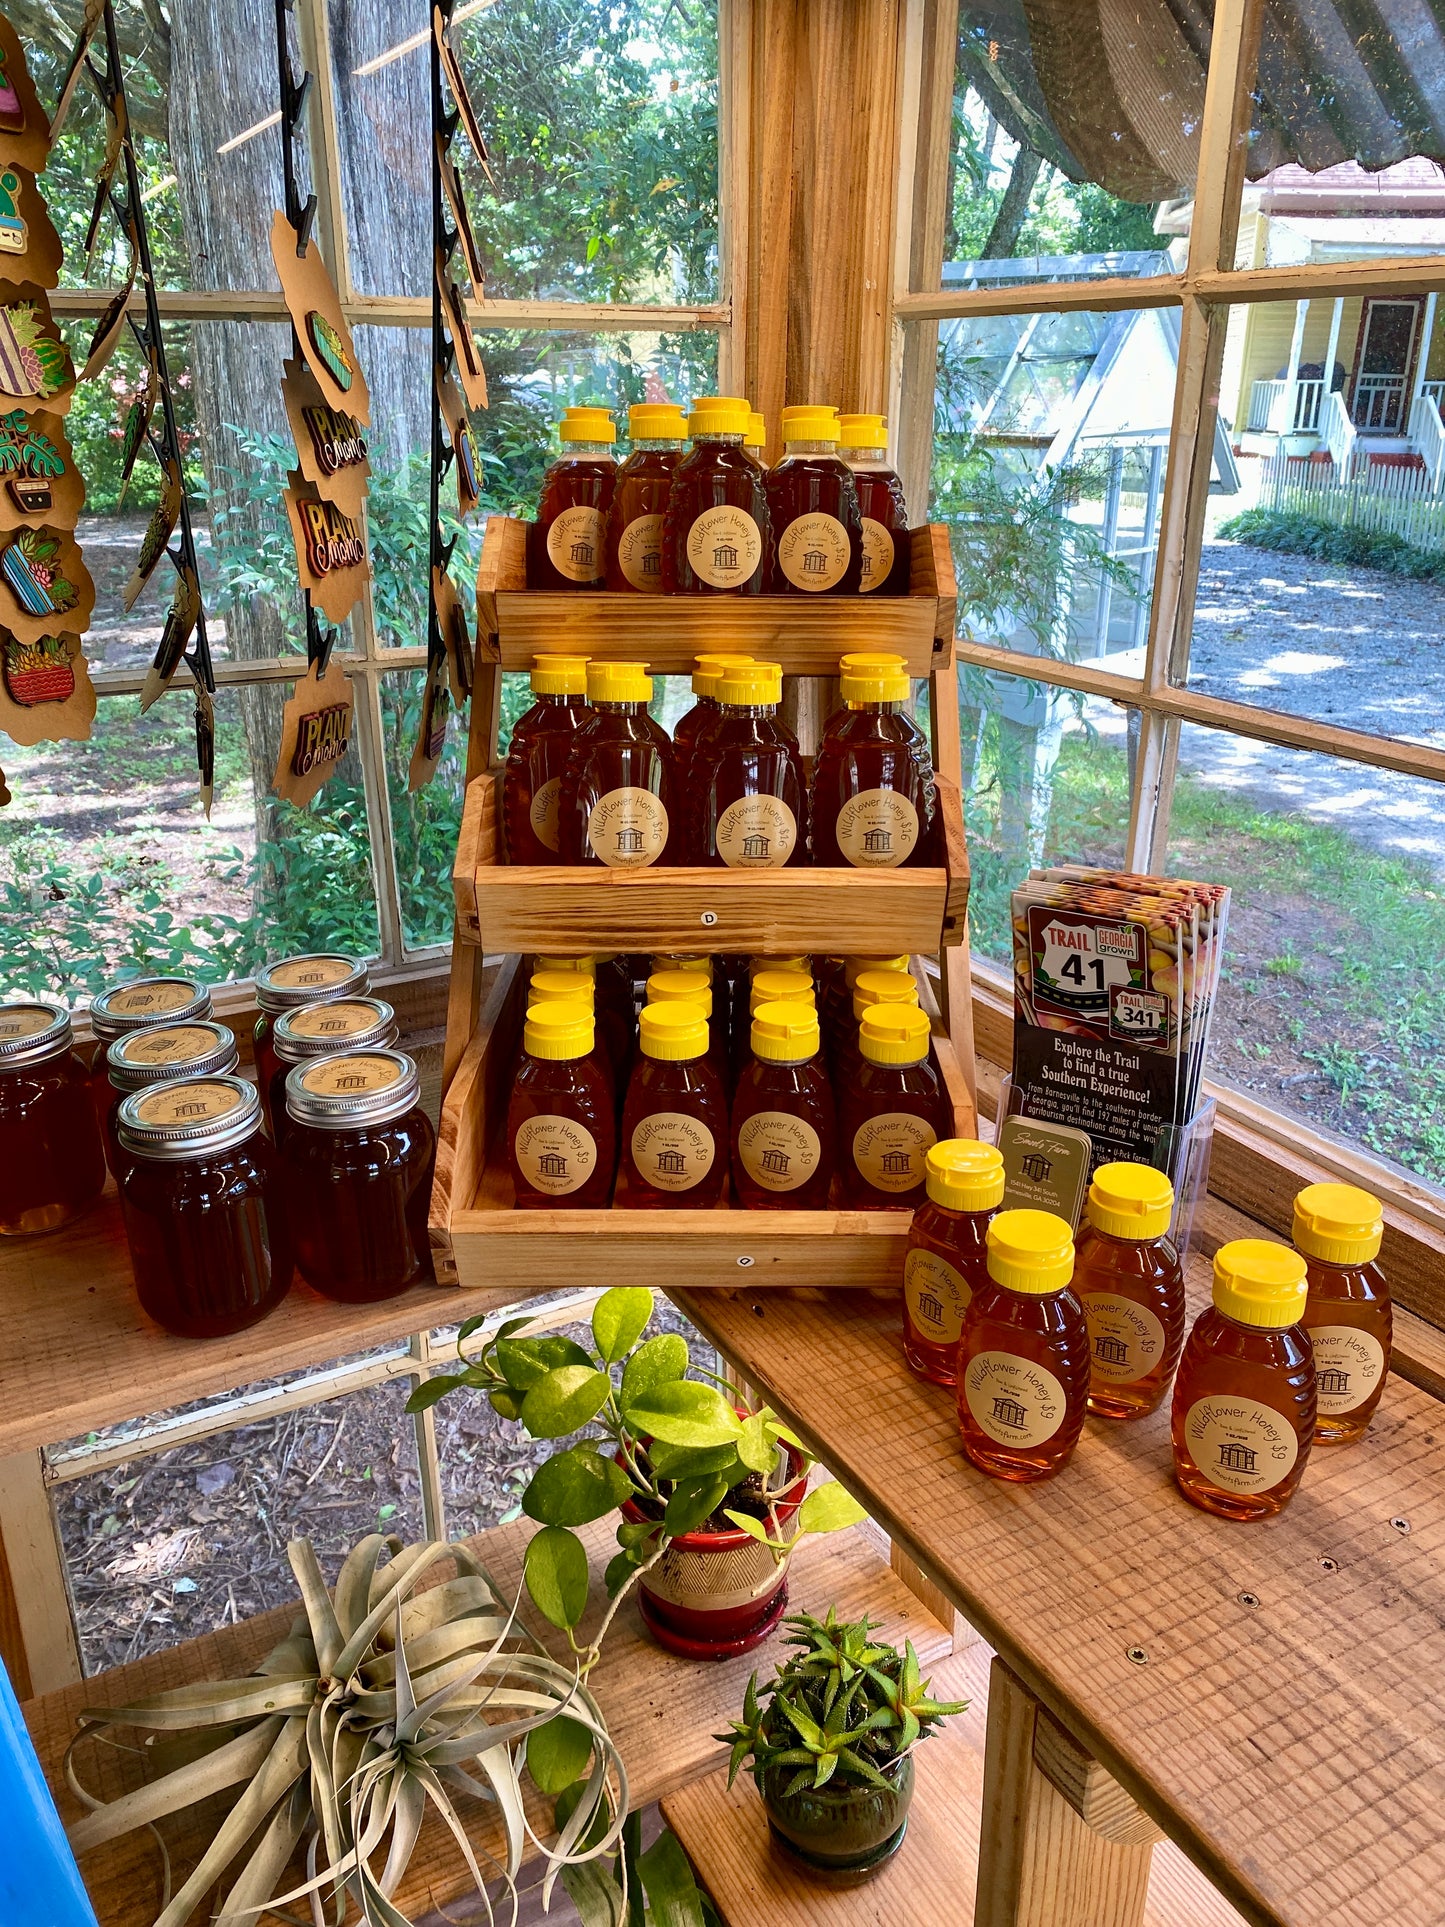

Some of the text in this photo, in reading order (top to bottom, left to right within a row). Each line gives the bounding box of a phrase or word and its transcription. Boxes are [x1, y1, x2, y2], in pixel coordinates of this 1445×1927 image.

[553, 514, 586, 549] Wildflower
[623, 523, 655, 563] Wildflower
[693, 515, 728, 556] Wildflower
[730, 515, 751, 539] Honey
[745, 539, 756, 559] $16
[783, 521, 846, 568] Wildflower Honey $16
[865, 525, 888, 567] Honey $16
[316, 537, 365, 572] mom
[302, 737, 349, 775] mom
[593, 796, 662, 841] Wildflower Honey $16
[720, 804, 760, 844] Wildflower
[763, 803, 785, 827] Honey
[778, 826, 789, 849] $16
[842, 798, 881, 839] Wildflower
[883, 798, 907, 821] Honey
[900, 820, 911, 842] $16
[705, 914, 714, 924] D
[1048, 927, 1092, 952] TRAIL
[1099, 929, 1134, 949] GEORGIA
[1099, 945, 1134, 957] grown
[1061, 954, 1104, 990] 41
[1120, 994, 1142, 1007] TRAIL
[1123, 1007, 1153, 1027] 341
[1054, 1038, 1140, 1070] Explore the Trail
[1063, 1056, 1130, 1083] to find a true
[1028, 1082, 1162, 1123] From Barnesville to the southern border
[1042, 1065, 1151, 1104] Southern Experience!
[1022, 1092, 1165, 1136] of Georgia, you'll find 192 miles of unique
[1028, 1105, 1065, 1121] agritourism
[1067, 1115, 1106, 1132] destinations
[1109, 1124, 1126, 1139] along
[1129, 1129, 1140, 1140] the
[519, 1123, 557, 1155] Wildflower
[559, 1125, 585, 1151] Honey
[577, 1151, 590, 1164] $9
[636, 1122, 678, 1153] Wildflower
[680, 1122, 703, 1148] Honey
[695, 1148, 708, 1162] $9
[742, 1119, 788, 1148] Wildflower
[789, 1122, 811, 1150] Honey
[801, 1150, 813, 1166] $9
[858, 1121, 900, 1158] Wildflower
[903, 1120, 926, 1146] Honey
[1046, 1139, 1072, 1156] Farm
[1132, 1152, 1150, 1164] Farms
[1021, 1182, 1033, 1192] Hwy
[1033, 1185, 1043, 1194] 341
[1043, 1188, 1058, 1198] South
[1043, 1198, 1061, 1208] 30204
[907, 1255, 938, 1287] Wildflower
[939, 1270, 963, 1302] Honey
[953, 1302, 966, 1320] $9
[1122, 1302, 1151, 1337] Honey
[1140, 1339, 1156, 1354] $9
[1344, 1337, 1376, 1378] Honey $9
[969, 1358, 1022, 1391] Wildflower
[1023, 1370, 1051, 1401] Honey
[1040, 1404, 1056, 1419] $9
[984, 1418, 1033, 1441] smootsfarm.com
[1191, 1403, 1247, 1440] Wildflower
[1249, 1411, 1282, 1442] Honey
[1270, 1445, 1288, 1460] $9
[1210, 1467, 1266, 1487] smootsfarm.com
